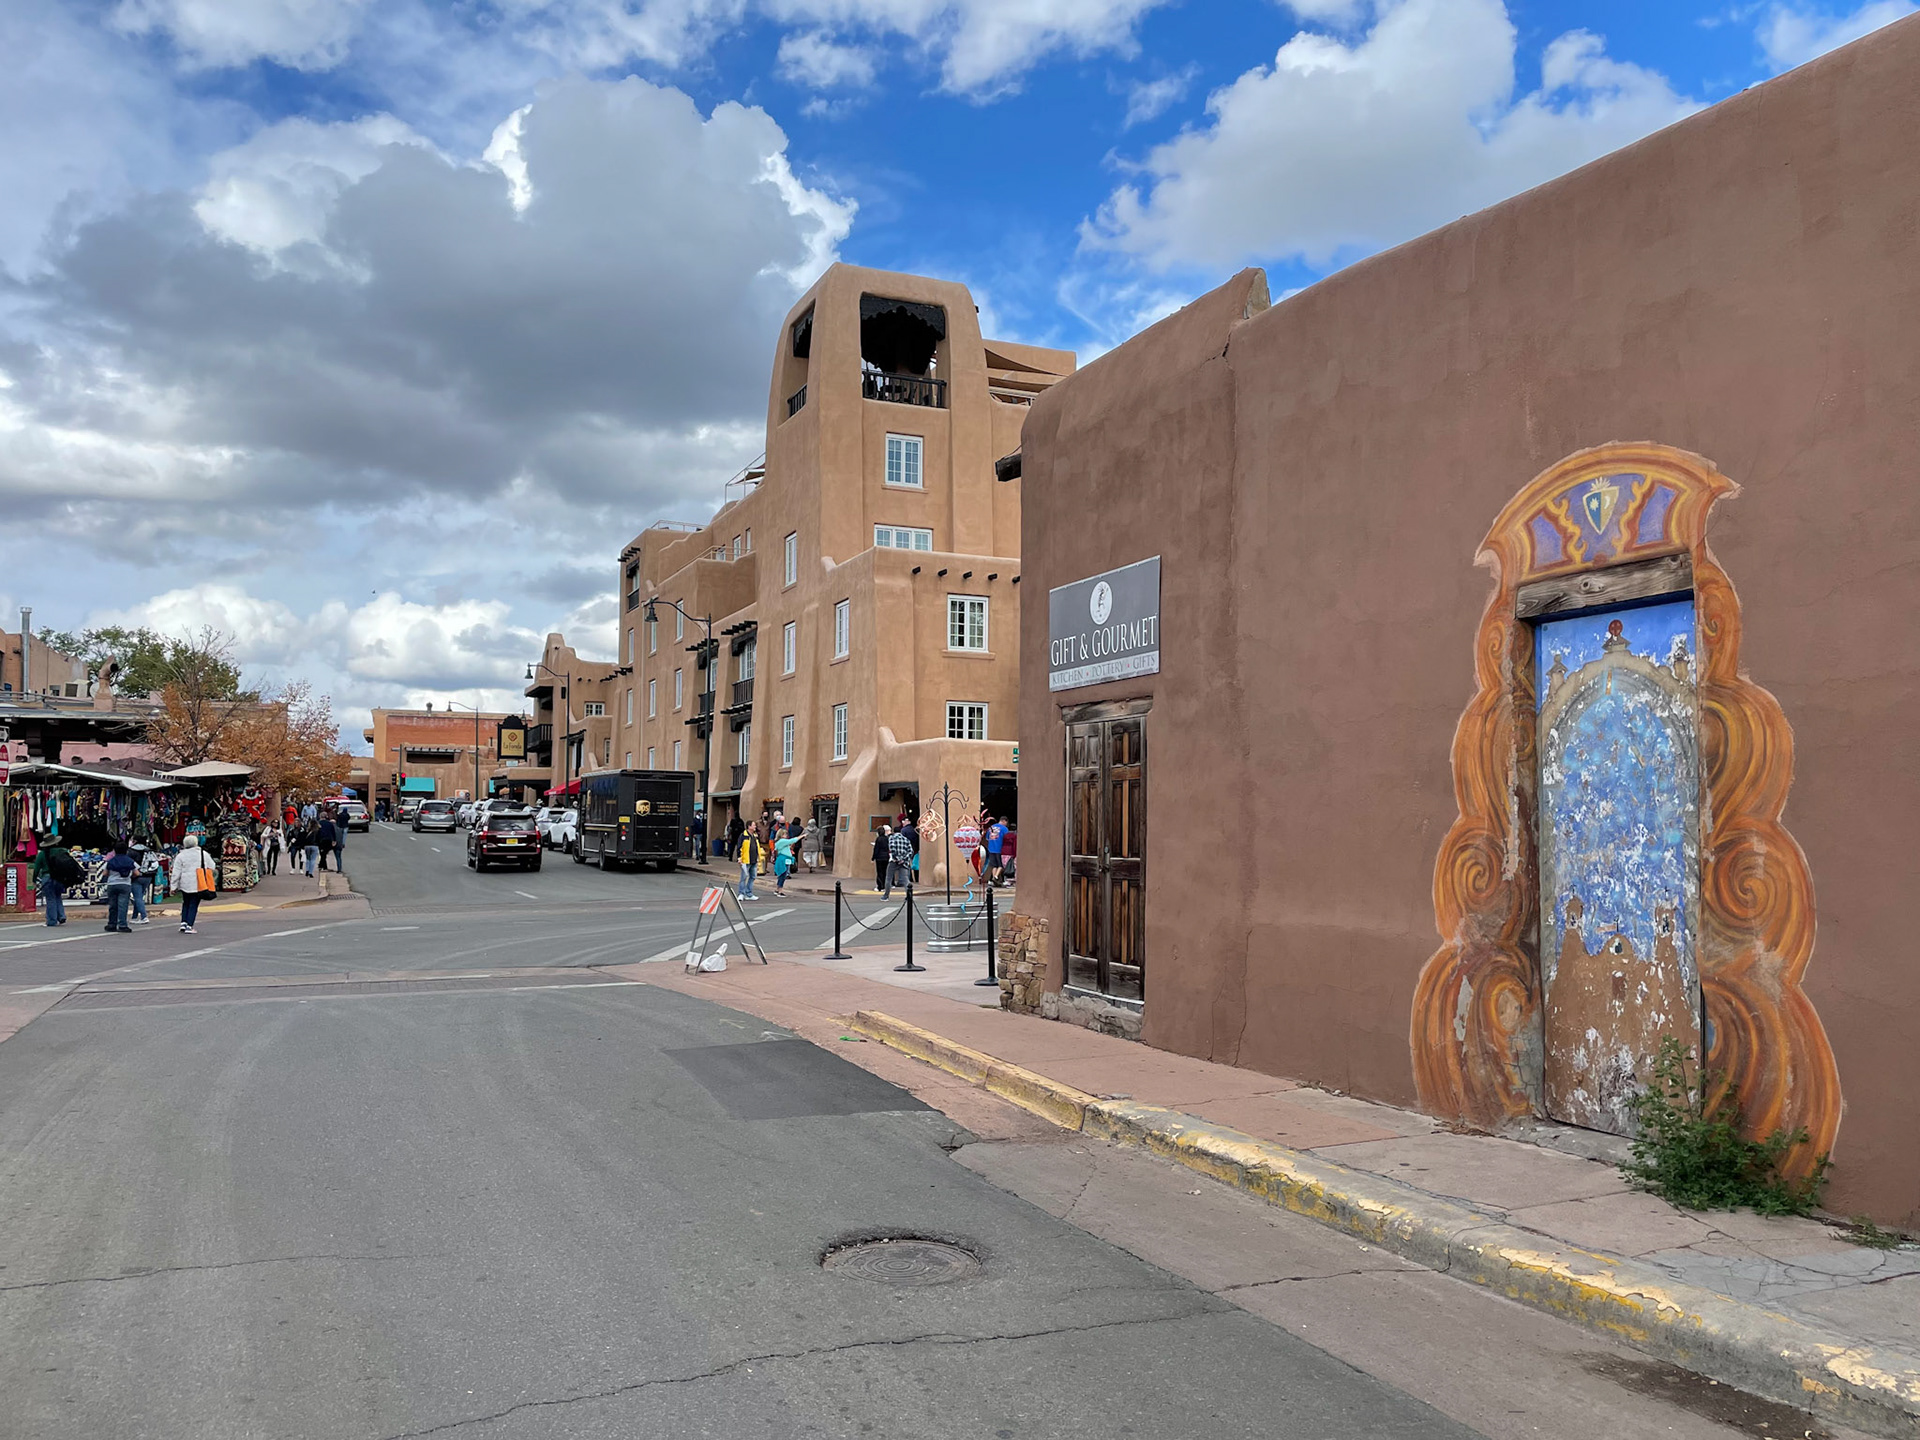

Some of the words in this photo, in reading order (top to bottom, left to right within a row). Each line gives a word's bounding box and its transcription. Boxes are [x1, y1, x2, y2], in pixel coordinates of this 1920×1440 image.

[1051, 635, 1077, 667] GIFT
[1079, 633, 1089, 661] &
[1091, 615, 1157, 658] GOURMET
[1092, 661, 1123, 676] POTTERY
[1132, 654, 1155, 670] GIFTS
[7, 867, 17, 905] REPORTER
